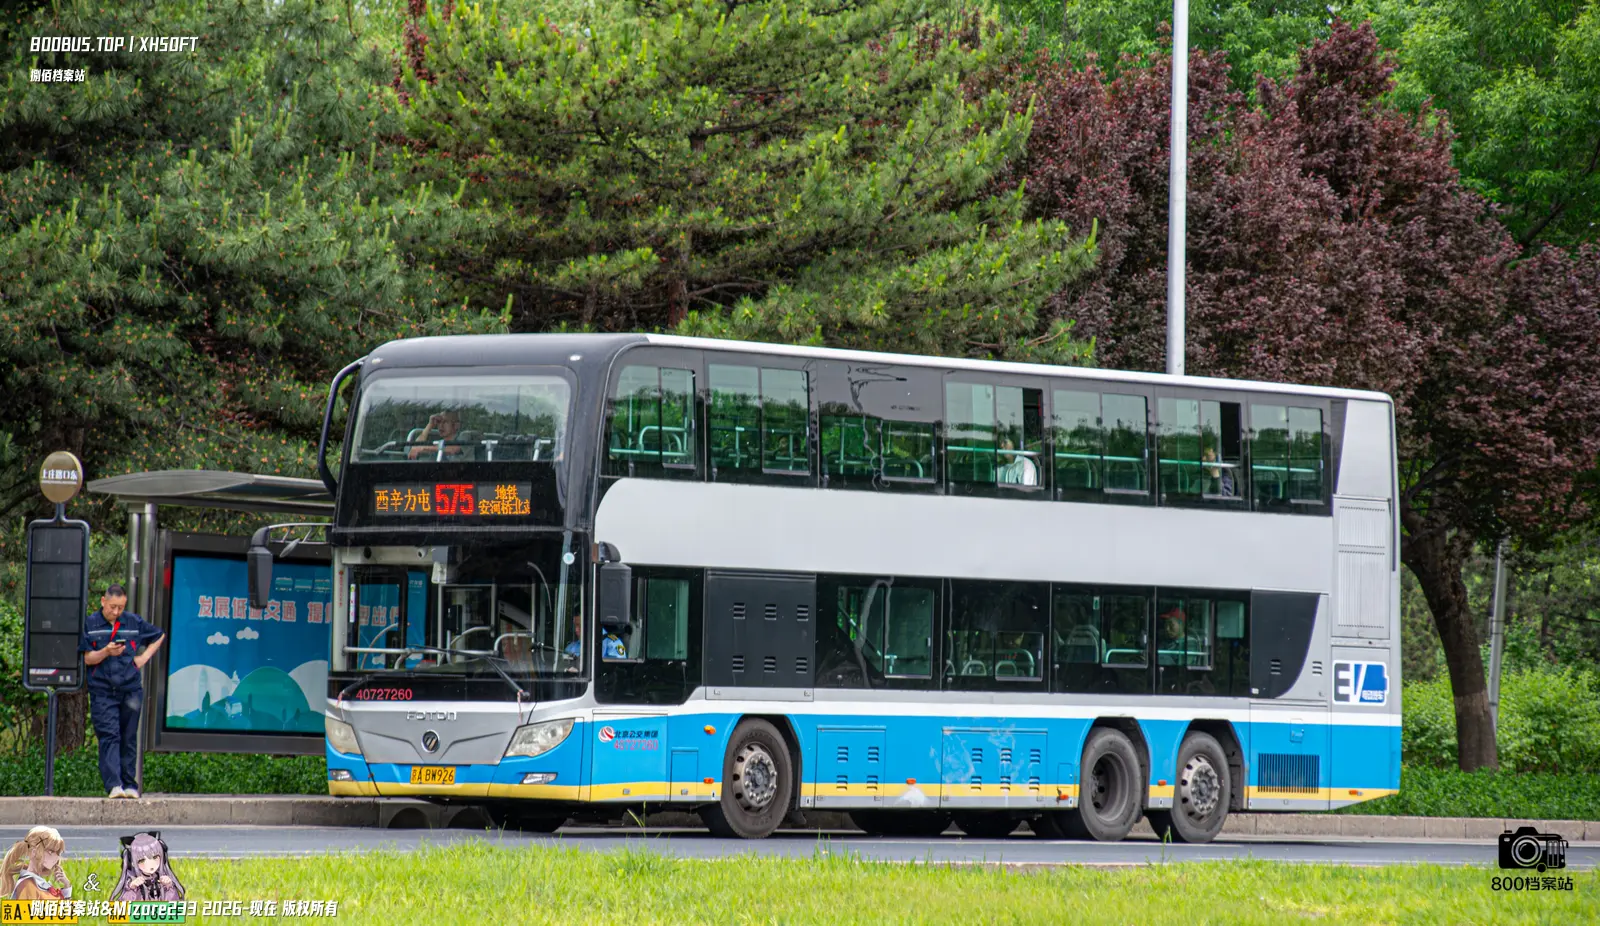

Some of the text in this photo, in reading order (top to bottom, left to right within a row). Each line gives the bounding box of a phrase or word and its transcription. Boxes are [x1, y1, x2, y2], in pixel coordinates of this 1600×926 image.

[494, 484, 518, 500] 地铁
[375, 484, 475, 515] 西辛力屯 575
[356, 688, 413, 700] 40727260
[406, 710, 457, 720] FOTON
[614, 730, 659, 739] 北京公交集团
[614, 739, 659, 751] 40727260
